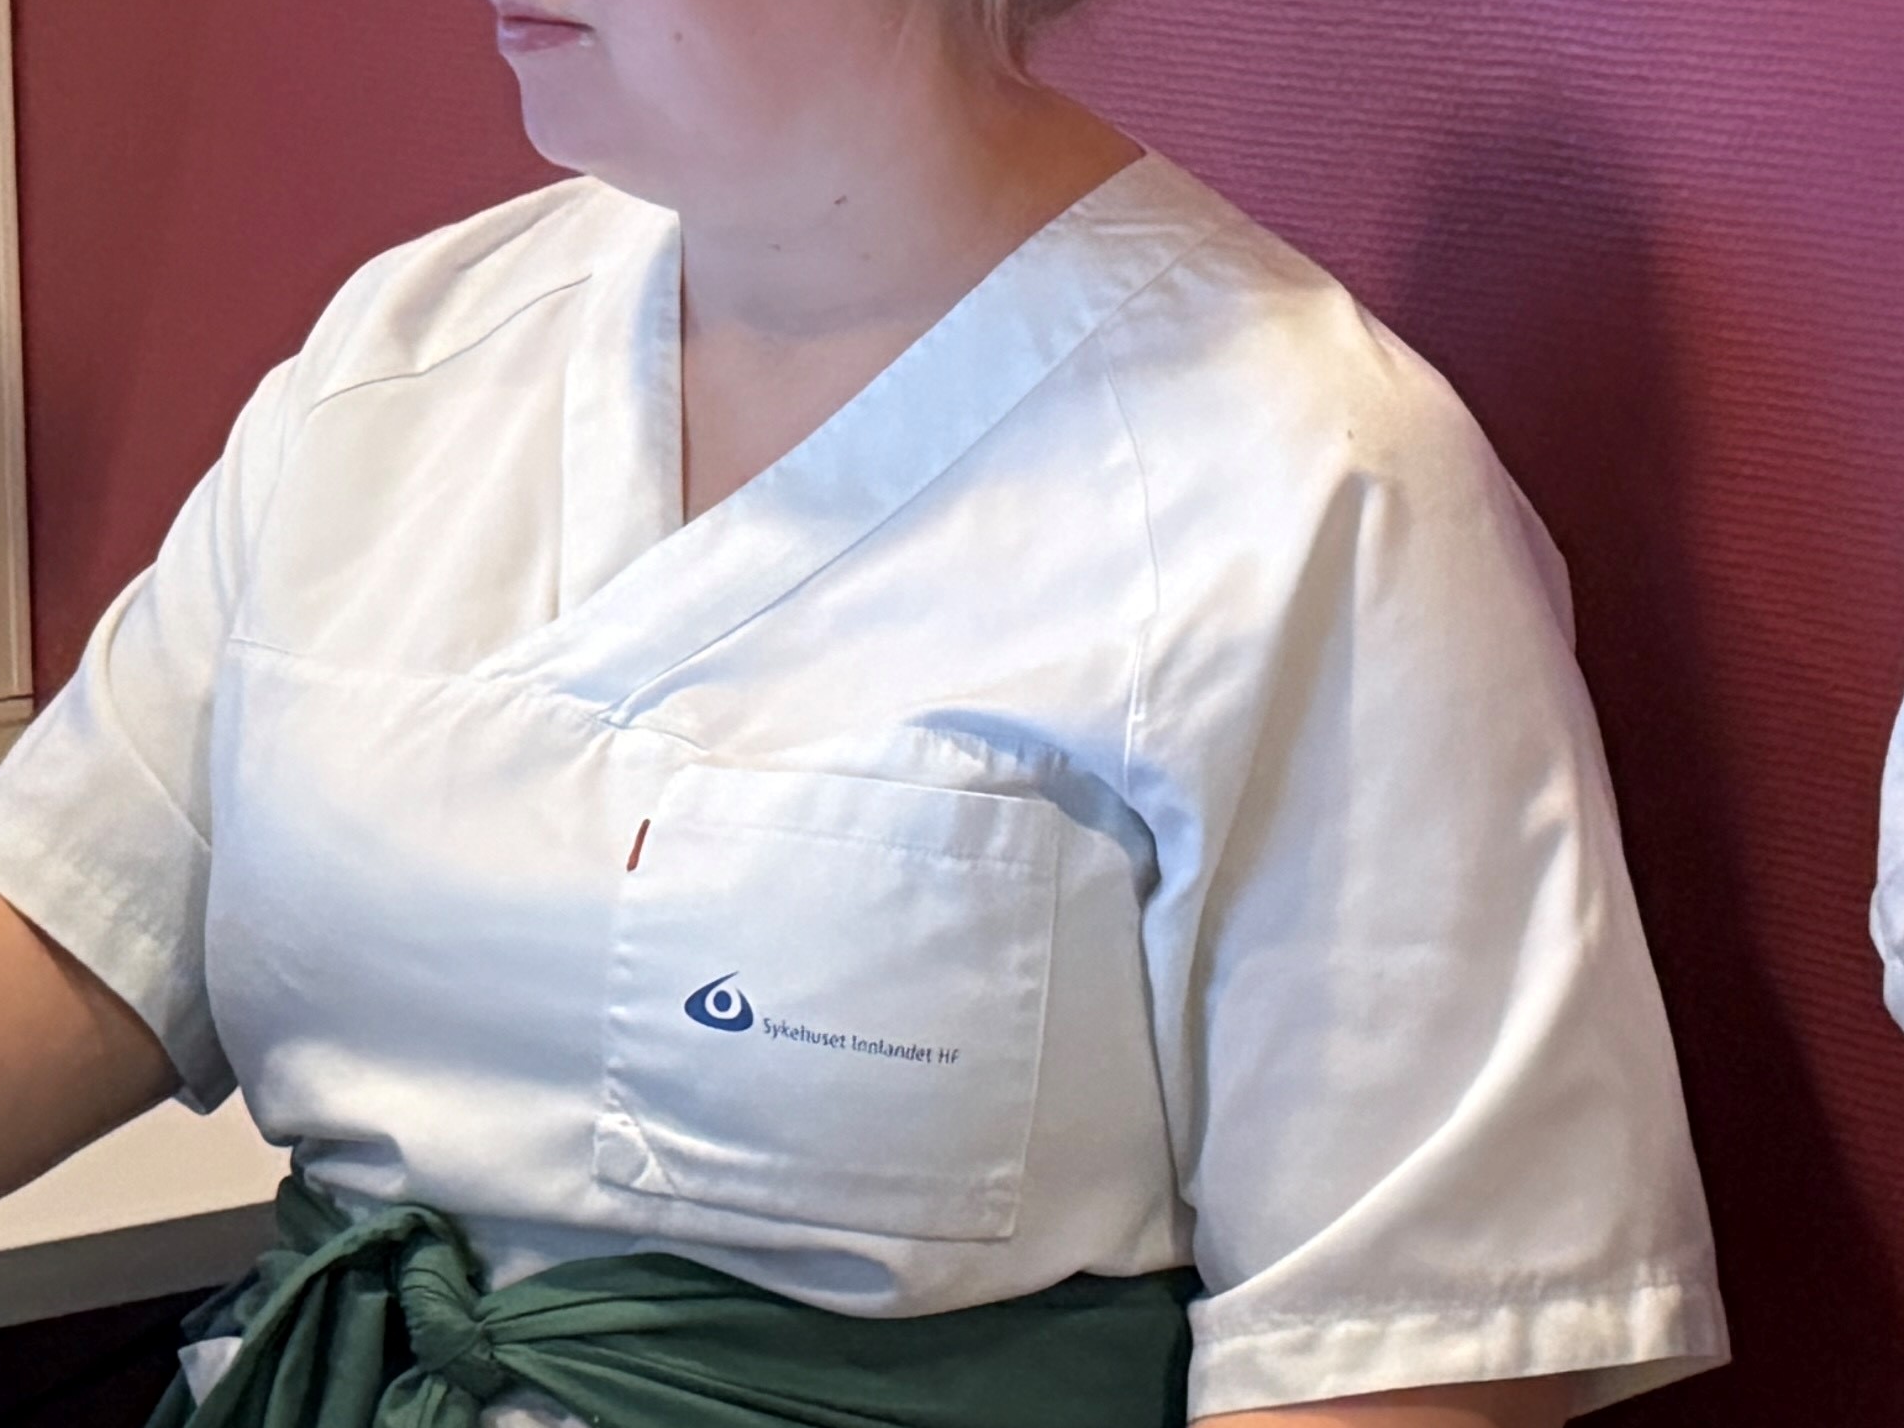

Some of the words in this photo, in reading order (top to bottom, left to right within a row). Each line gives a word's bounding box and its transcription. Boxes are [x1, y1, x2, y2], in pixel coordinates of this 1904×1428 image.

[763, 1017, 846, 1049] Sykehuset
[851, 1035, 932, 1063] Innlandet
[938, 1048, 960, 1064] HF
